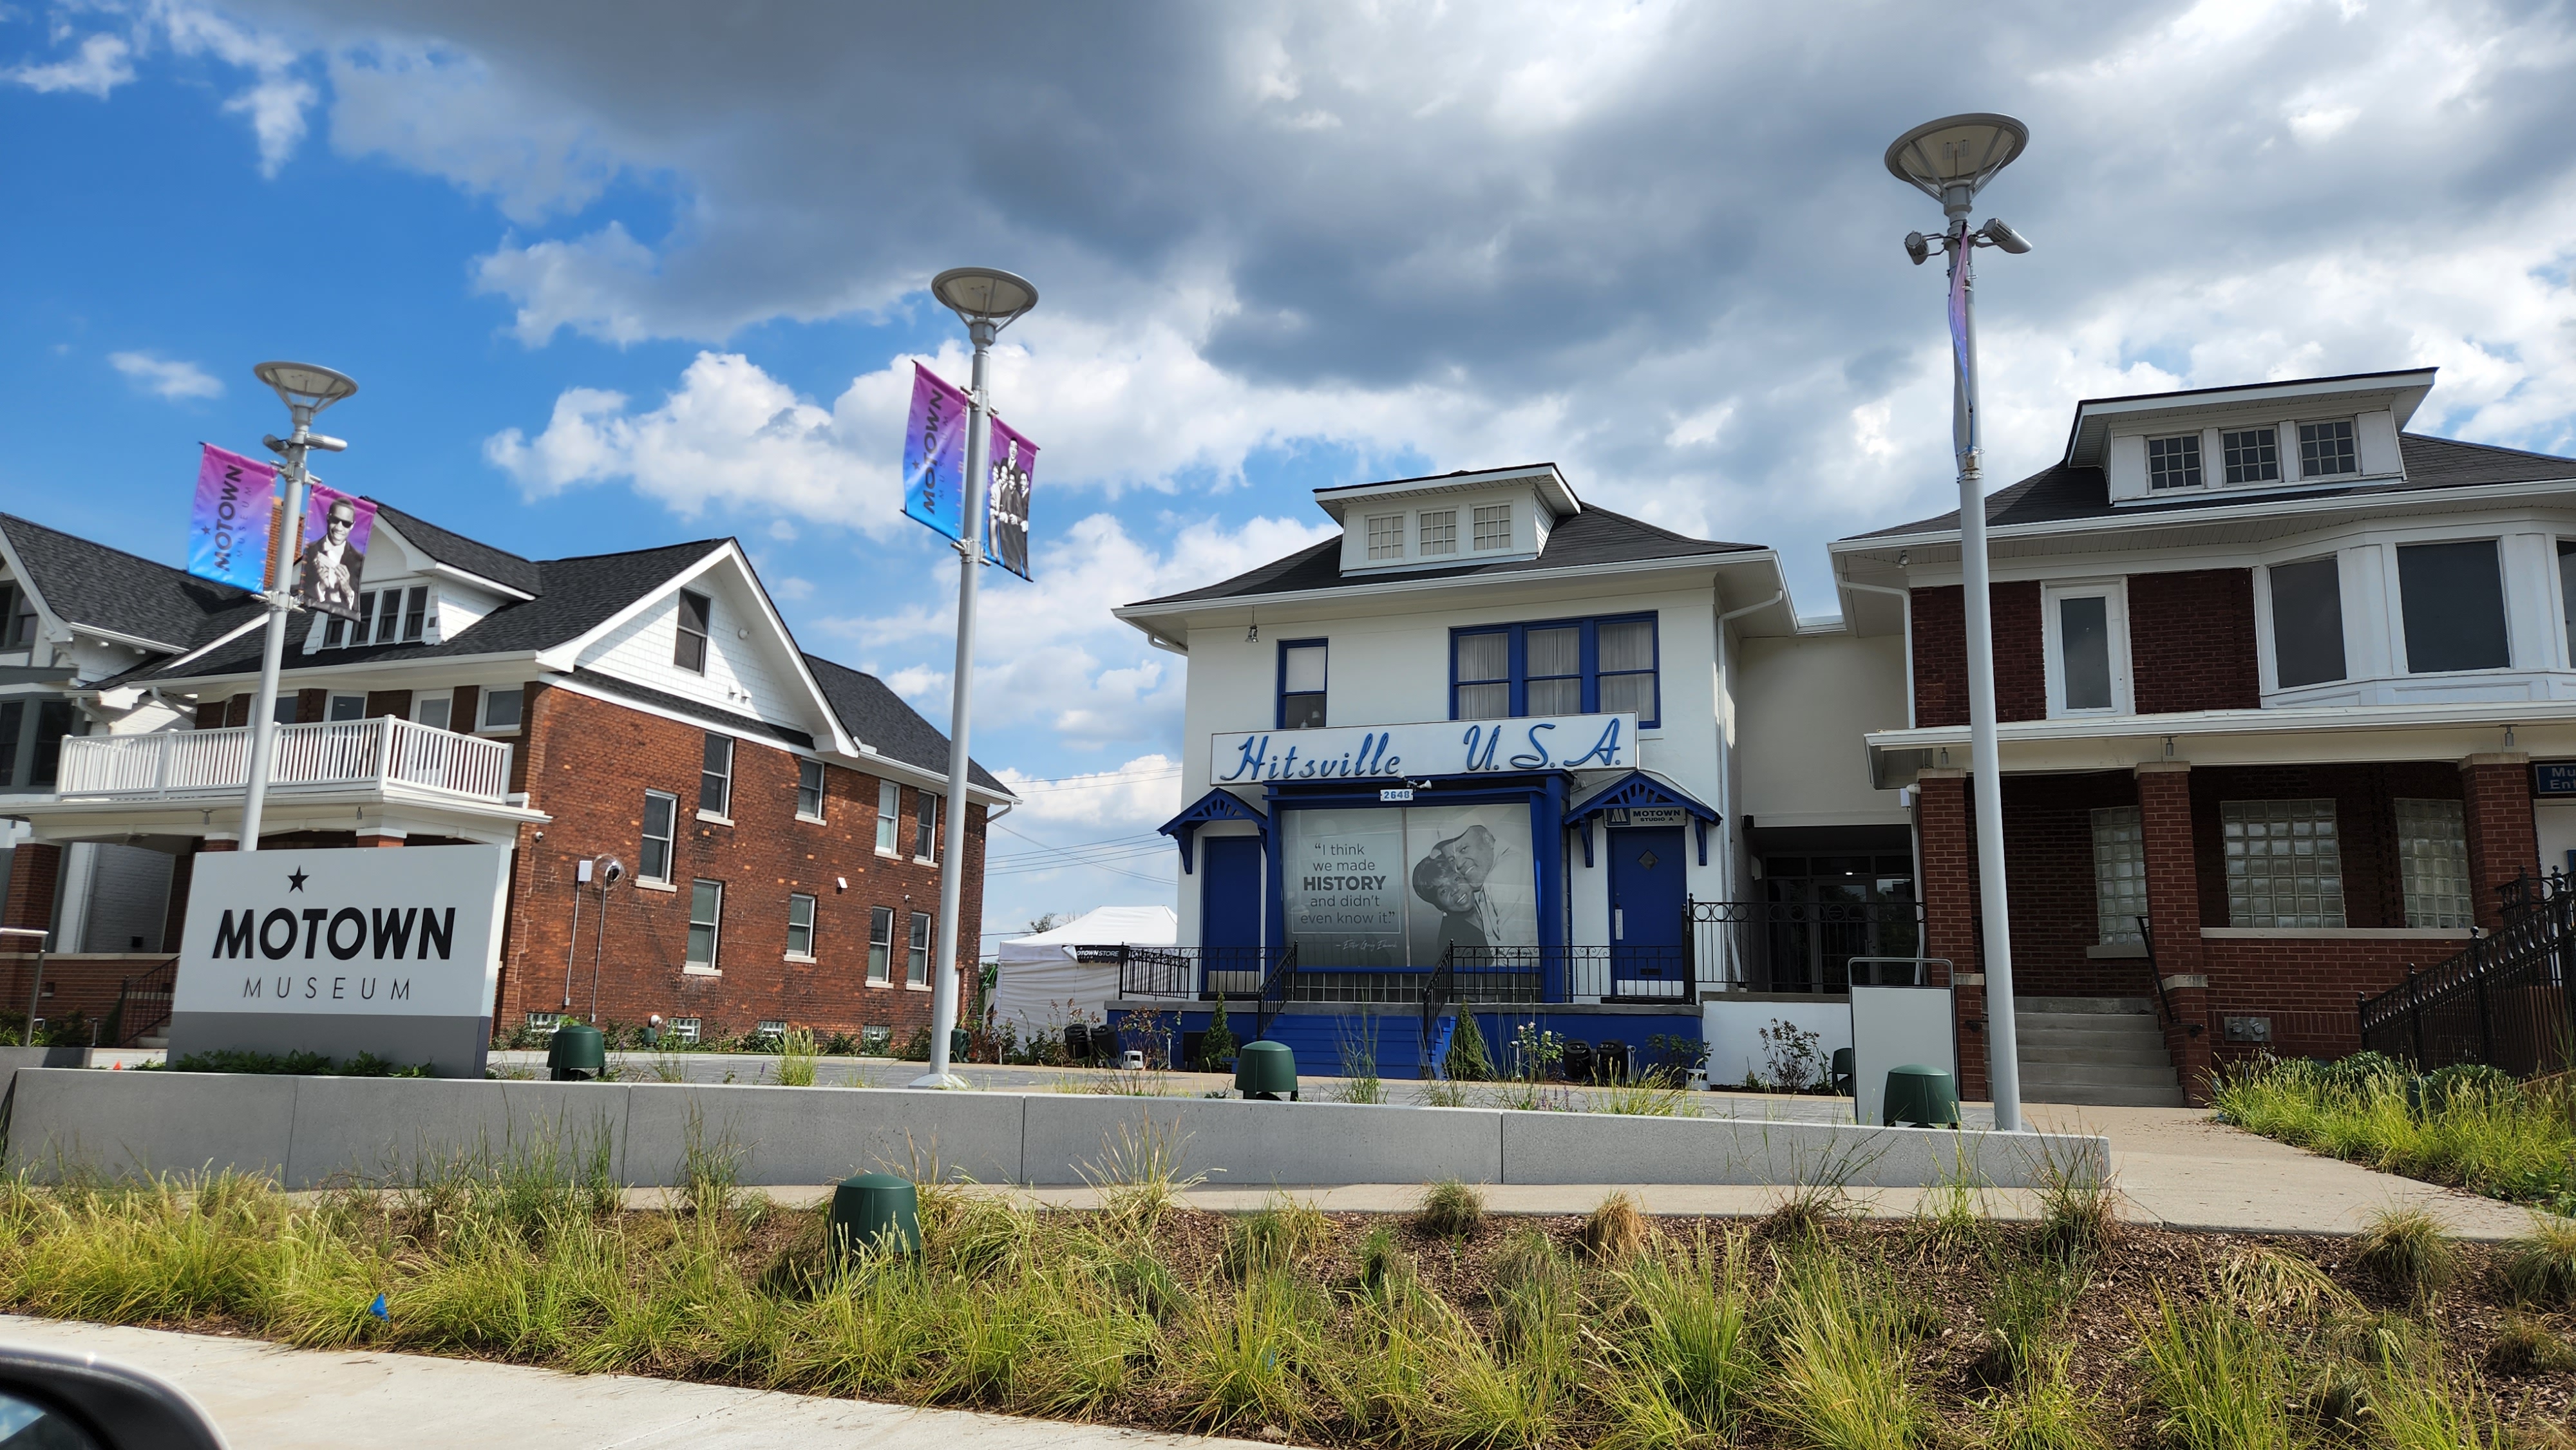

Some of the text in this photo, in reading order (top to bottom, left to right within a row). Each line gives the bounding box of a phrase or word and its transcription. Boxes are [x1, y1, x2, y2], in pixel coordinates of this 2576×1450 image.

[923, 388, 943, 515] MOTOWN
[938, 415, 949, 500] MUSEUM
[214, 464, 244, 572] MOTOWN
[236, 486, 252, 558] MUSEUM
[1220, 732, 1401, 781] Hitsville
[1383, 790, 1410, 799] 2648
[1331, 843, 1365, 856] think
[1312, 858, 1376, 871] we made
[1303, 875, 1387, 891] HISTORY
[1310, 894, 1380, 907] and didn't
[1300, 914, 1332, 924] even
[1337, 912, 1374, 924] know
[212, 907, 457, 961] MOTOWN
[243, 976, 410, 1001] MUSEUM
